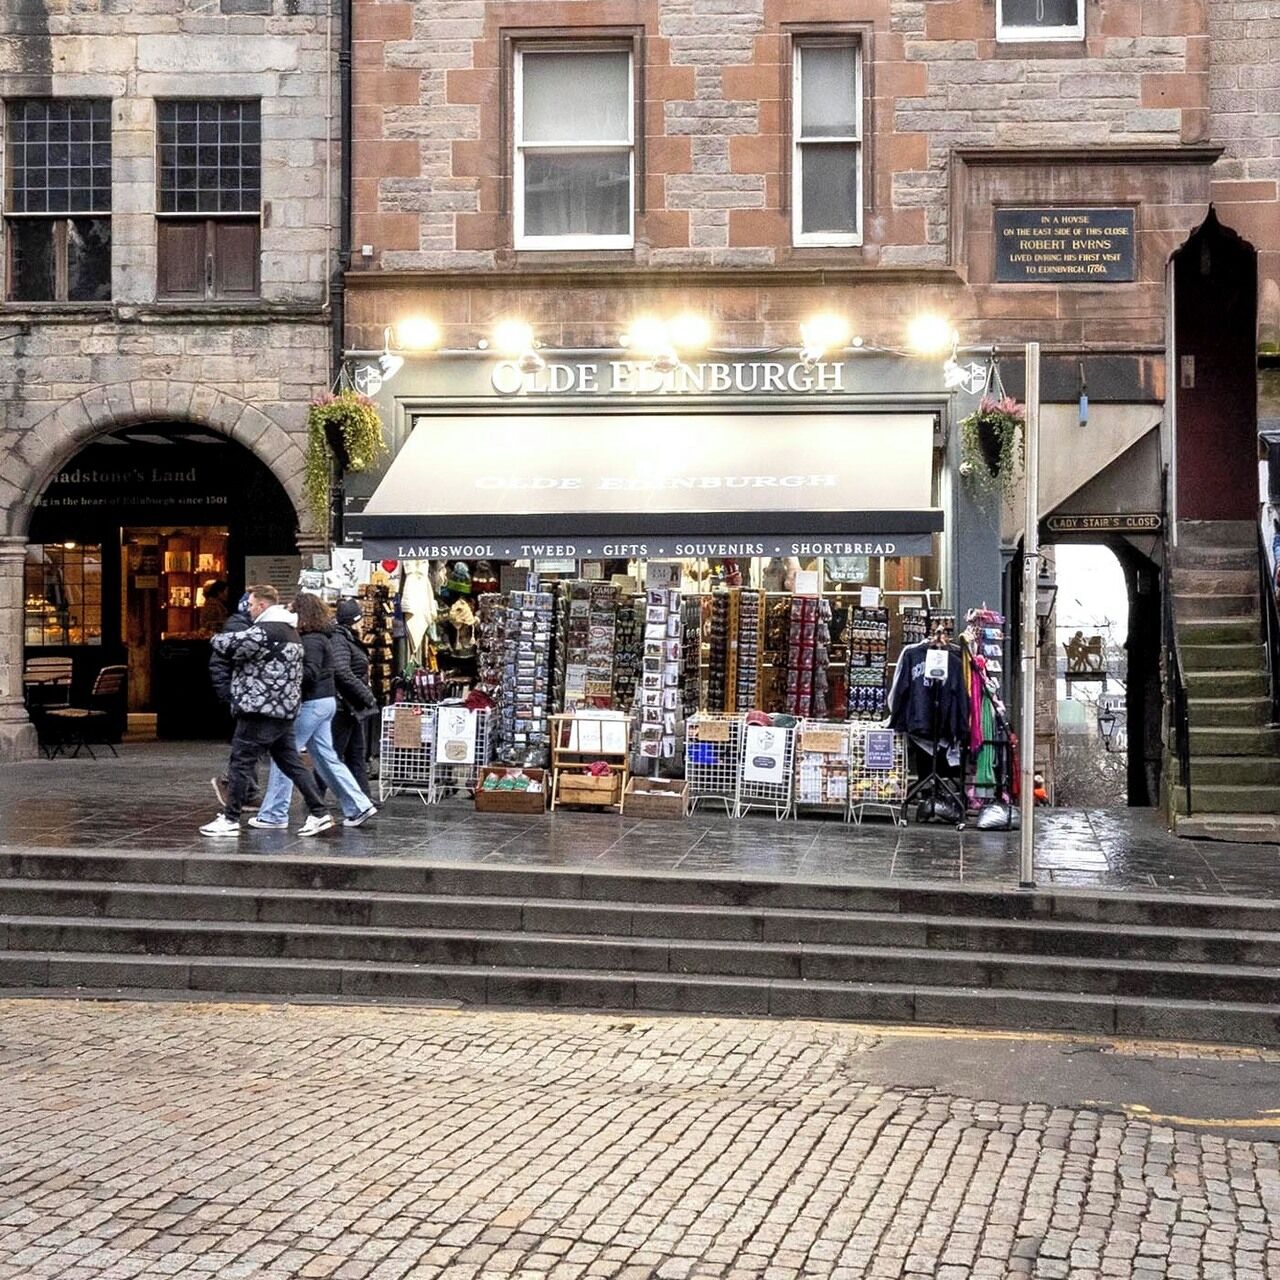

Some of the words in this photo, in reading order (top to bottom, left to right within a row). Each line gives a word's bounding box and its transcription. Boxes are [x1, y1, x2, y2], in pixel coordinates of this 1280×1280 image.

[1040, 216, 1050, 224] IN
[1053, 216, 1059, 224] A
[1003, 228, 1015, 236] ON
[1016, 228, 1031, 236] THE
[1033, 228, 1052, 236] EAST
[1055, 228, 1071, 236] SIDE
[1073, 227, 1083, 236] OF
[1086, 227, 1102, 235] THIS
[1020, 240, 1066, 250] ROBERT
[1072, 240, 1112, 250] BVRNS
[1010, 254, 1032, 262] LIVED
[1064, 254, 1077, 262] HIS
[1078, 254, 1099, 262] FIRST
[1102, 254, 1121, 262] VISIT
[1025, 266, 1036, 274] TO
[491, 363, 598, 394] OLDE
[609, 361, 845, 394] EDINBURGH
[151, 468, 196, 482] Land
[50, 496, 60, 506] in
[62, 496, 79, 506] the
[81, 496, 106, 506] heart
[108, 496, 120, 506] of
[179, 496, 203, 505] since
[206, 496, 228, 505] 1501
[1053, 519, 1078, 528] LADY
[1083, 518, 1120, 527] STAIR'S
[1126, 517, 1156, 526] CLOSE
[398, 545, 495, 557] LAMBSWOOL
[521, 545, 576, 556] TWEED
[603, 544, 648, 555] GIFTS
[675, 543, 764, 555] SOUVENIRS
[791, 542, 896, 554] SHORTBREAD
